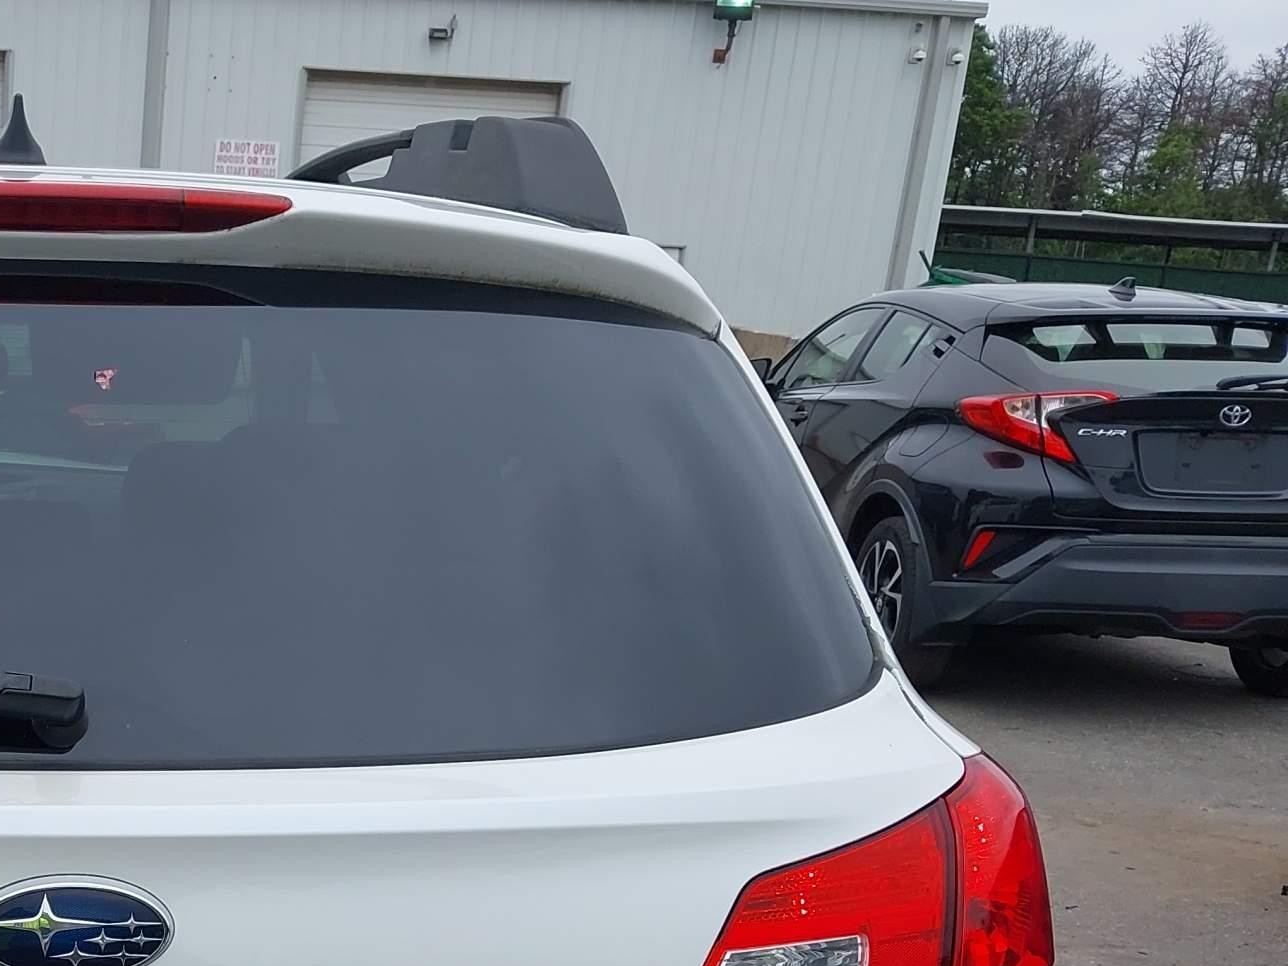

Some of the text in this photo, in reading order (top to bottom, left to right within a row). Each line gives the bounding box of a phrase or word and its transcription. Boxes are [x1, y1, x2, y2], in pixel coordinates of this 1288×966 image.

[219, 141, 276, 156] DO NOT OPEN
[216, 154, 276, 166] HOODS OR TRY
[1077, 428, 1128, 438] C-HR
